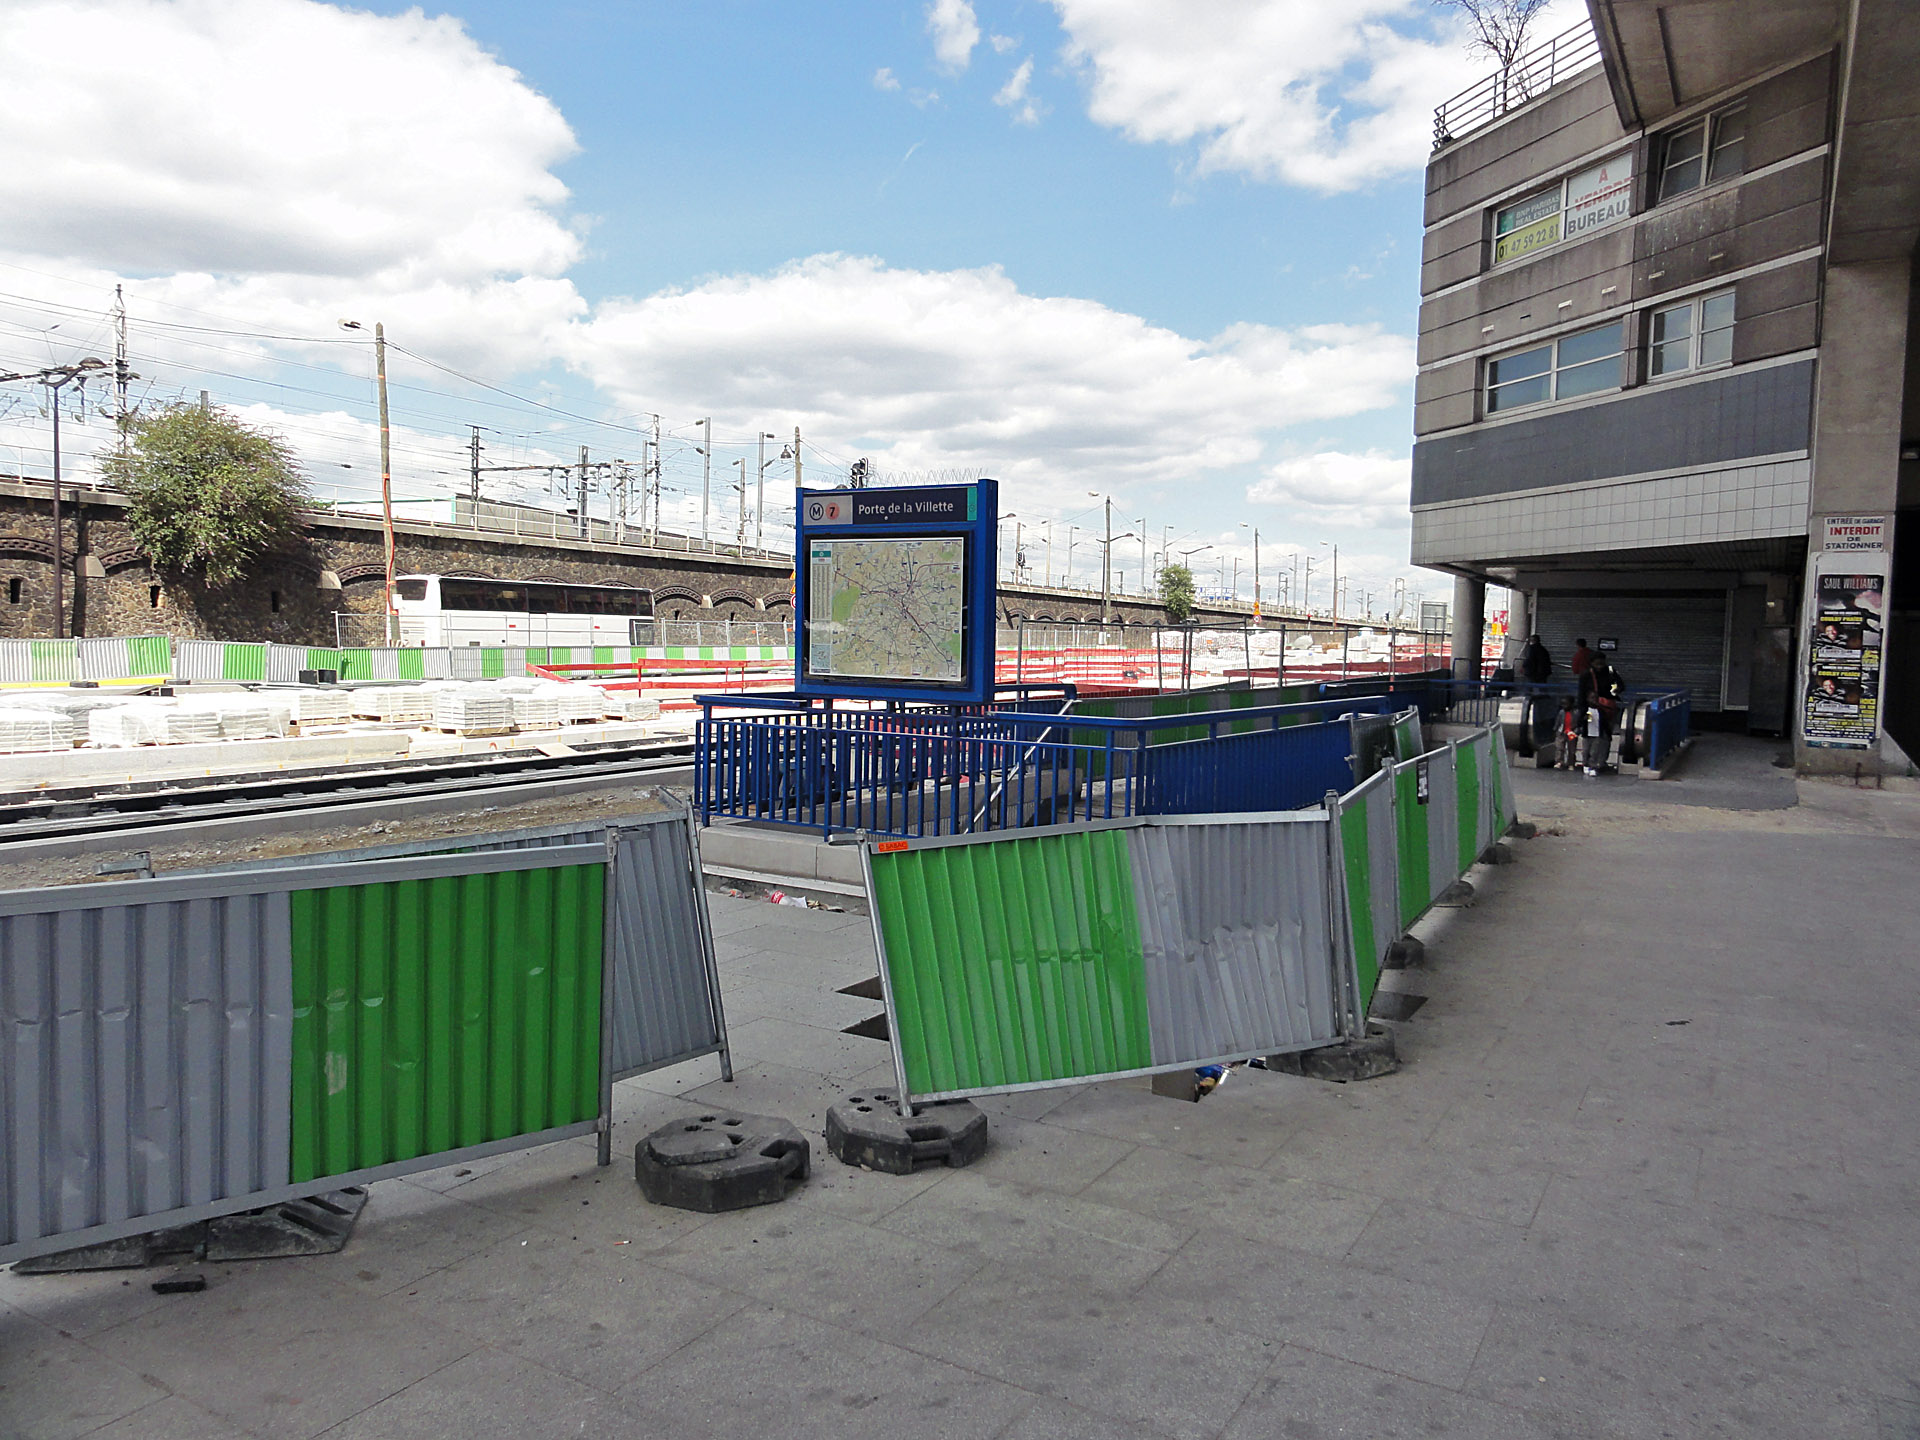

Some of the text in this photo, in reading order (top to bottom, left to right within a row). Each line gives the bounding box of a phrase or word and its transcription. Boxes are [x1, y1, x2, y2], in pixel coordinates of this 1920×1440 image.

[1599, 168, 1609, 184] A
[1499, 244, 1508, 258] 01
[1511, 238, 1521, 252] 47
[1523, 233, 1534, 249] 59
[1536, 228, 1547, 243] 22
[829, 506, 835, 517] 7
[858, 501, 953, 515] Porte de la Villette
[1830, 526, 1881, 536] INTERDIT
[1825, 542, 1883, 550] STATIONNER
[1824, 577, 1878, 589] SAUL WILLIAMS
